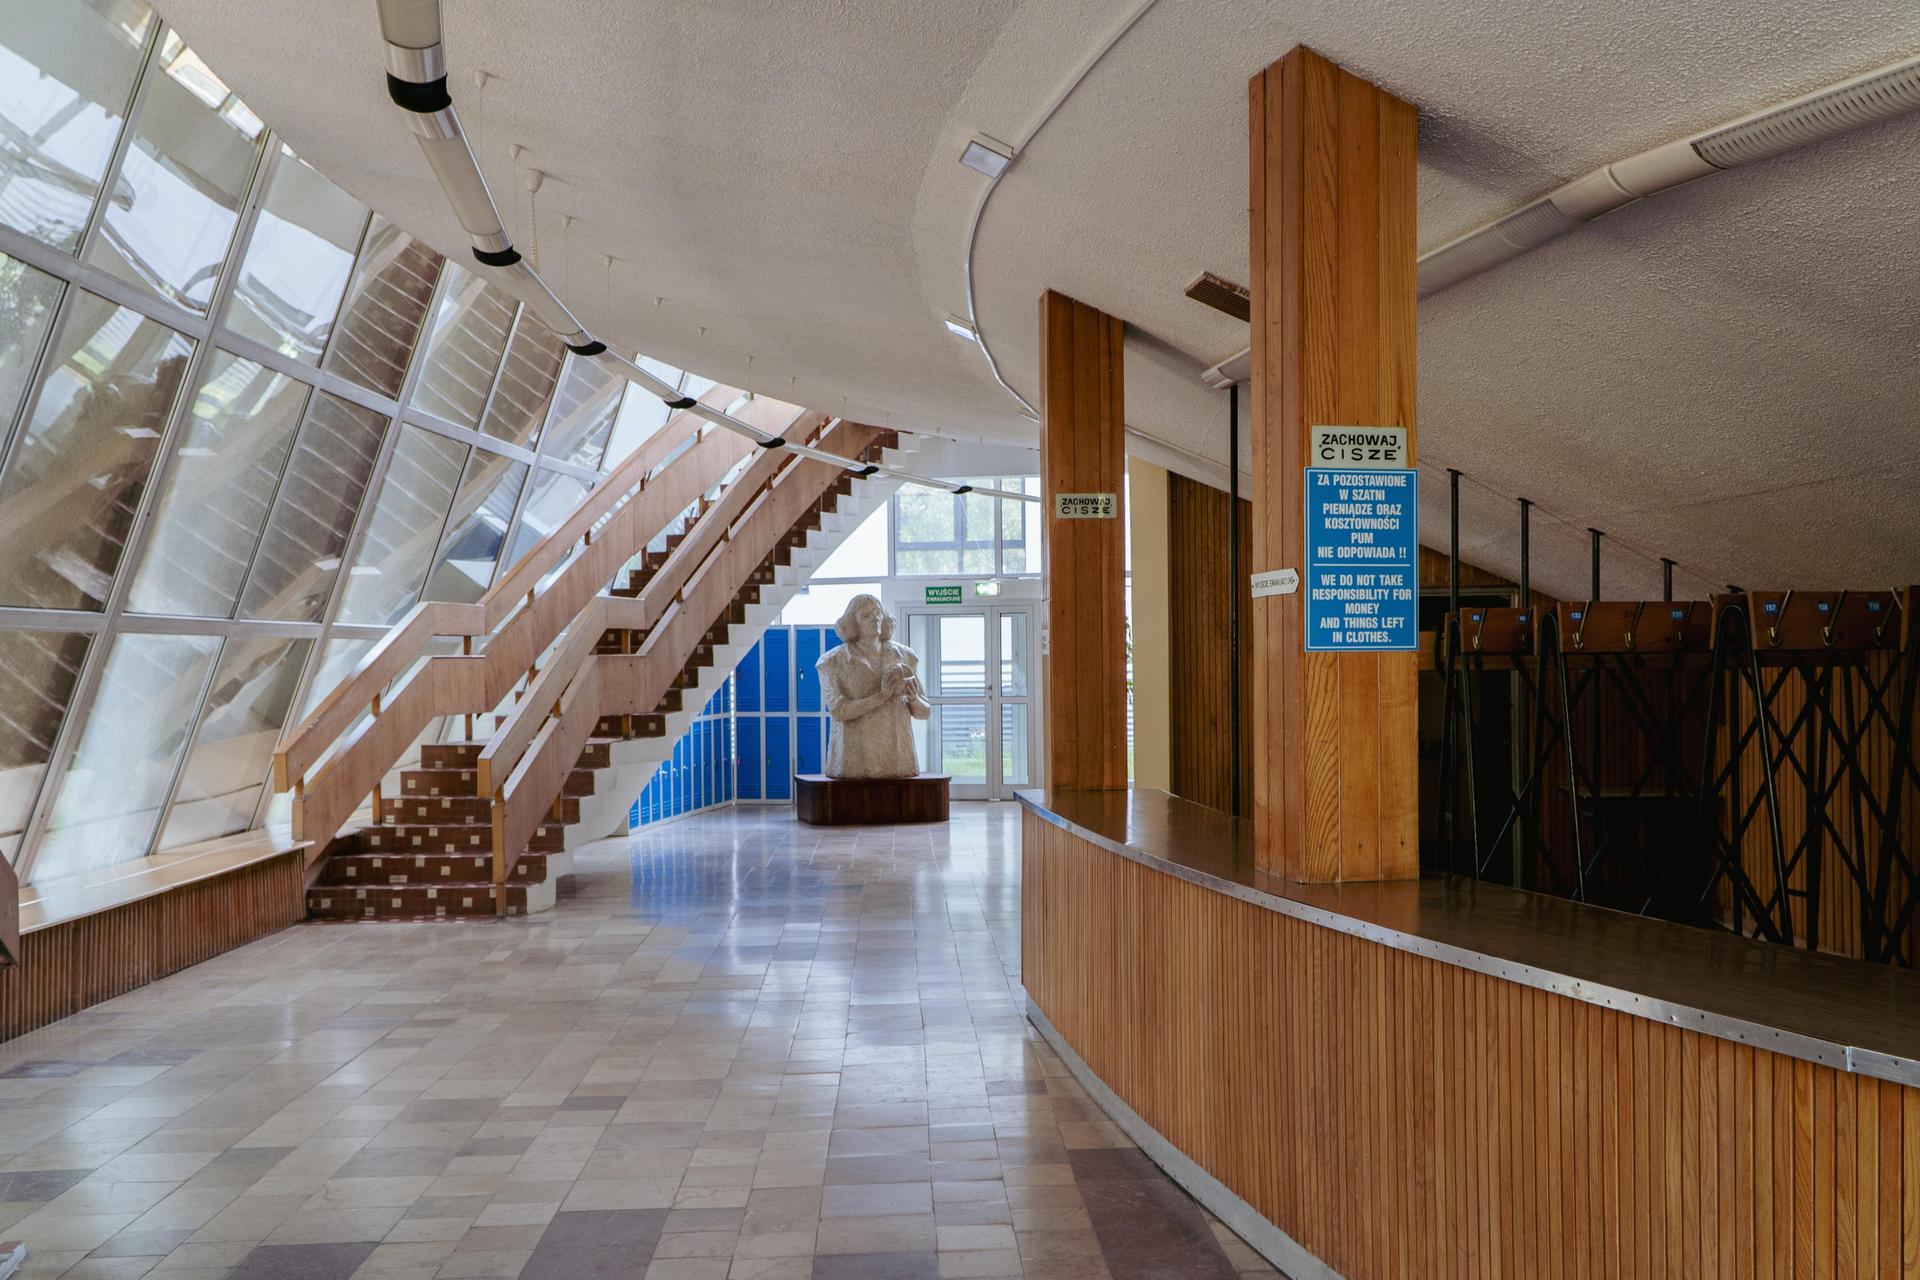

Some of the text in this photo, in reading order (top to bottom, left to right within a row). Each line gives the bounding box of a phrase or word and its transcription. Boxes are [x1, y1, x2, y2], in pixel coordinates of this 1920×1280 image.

[1321, 433, 1397, 446] ZACHOWAJ
[1317, 474, 1406, 487] ZA POZOSTAWIONE
[1339, 489, 1385, 501] W SZATNI
[1062, 497, 1111, 506] ZACHOWAJ
[1323, 503, 1402, 518] PIENIĄDZE ORAZ
[1325, 515, 1400, 530] KOSZTOWNOŚCI
[1351, 532, 1374, 544] PUM
[1317, 546, 1334, 558] NIE
[1337, 546, 1396, 558] ODPOWIADA
[1321, 574, 1403, 586] WE DO NOT TAKE
[928, 586, 960, 596] WYJŚCIE
[1312, 588, 1412, 600] RESPONSIBILITY FOR
[1345, 602, 1380, 614] MONEY
[1765, 604, 1776, 612] 157
[1320, 617, 1405, 629] AND THINGS LEFT
[1332, 631, 1392, 643] IN CLOTHES.
